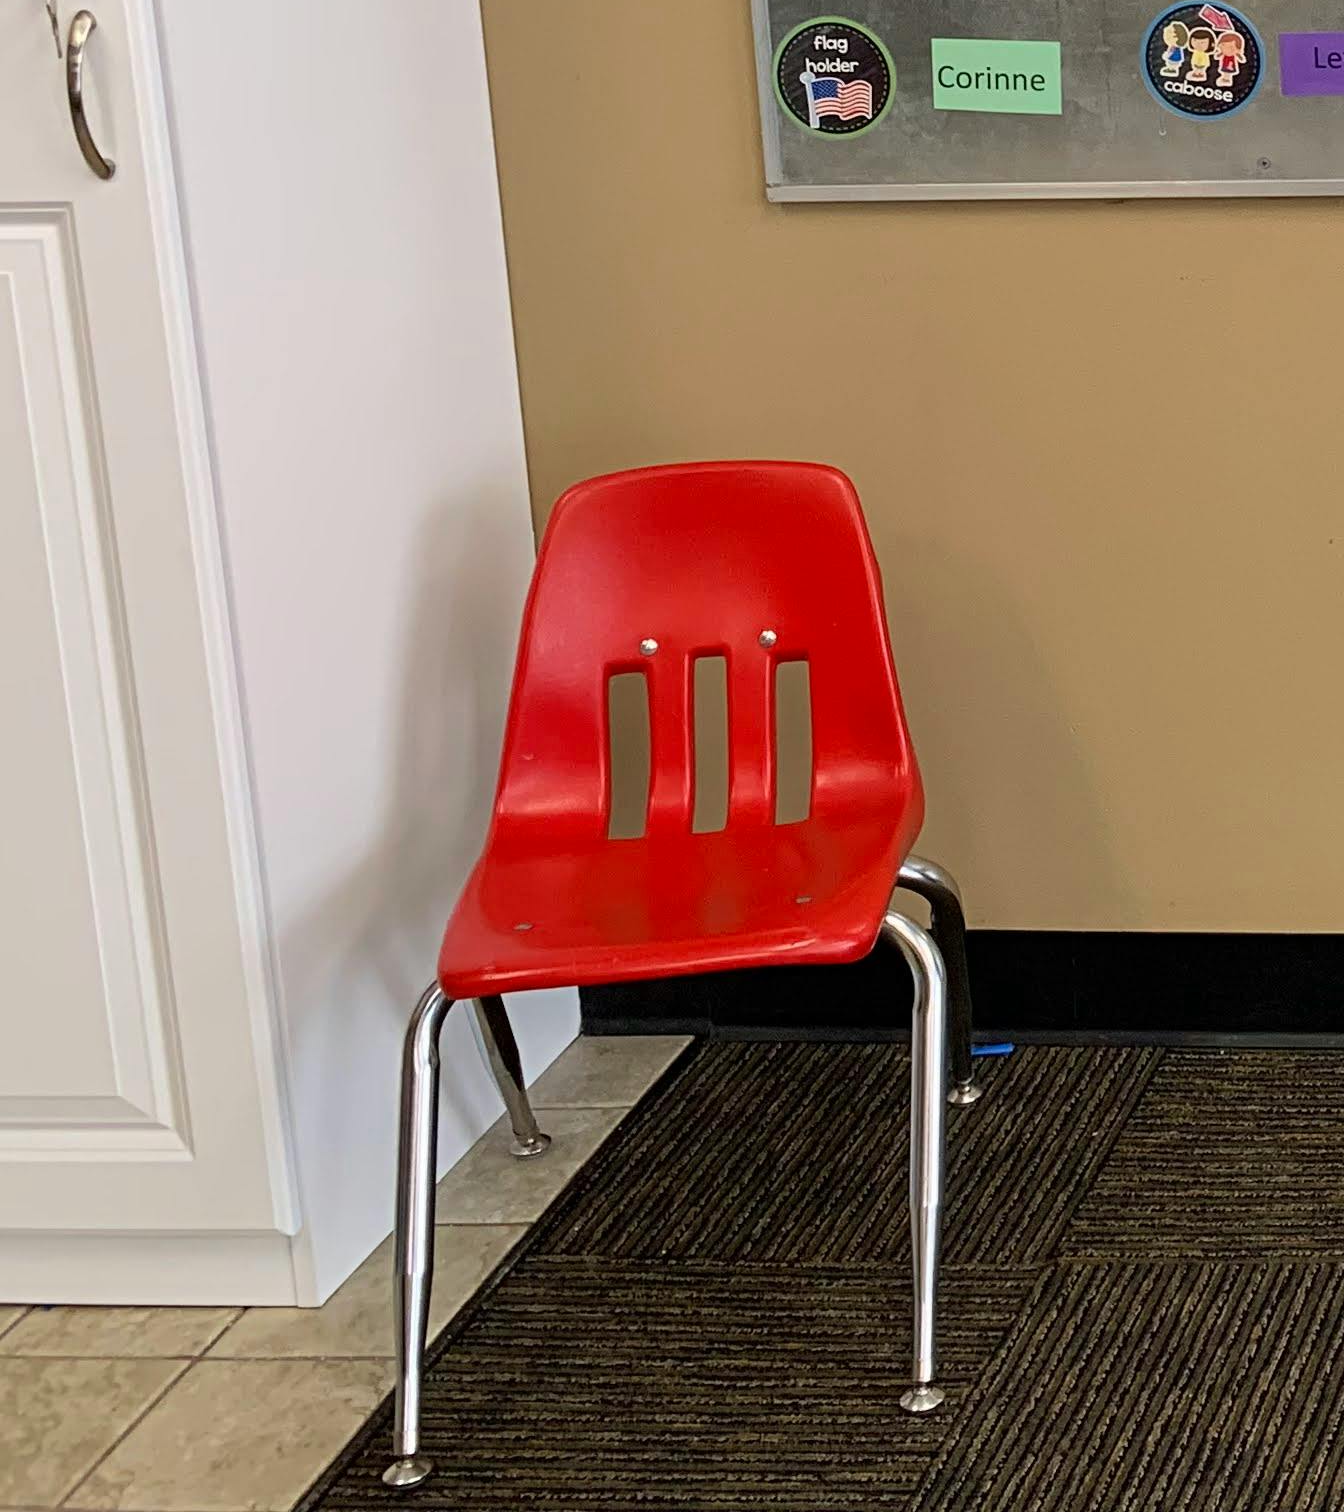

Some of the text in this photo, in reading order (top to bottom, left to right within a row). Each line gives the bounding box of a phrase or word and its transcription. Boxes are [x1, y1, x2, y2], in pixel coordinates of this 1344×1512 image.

[814, 35, 848, 53] flag
[805, 57, 859, 73] holder
[938, 65, 1046, 91] Corinne
[1164, 79, 1233, 102] caboose
